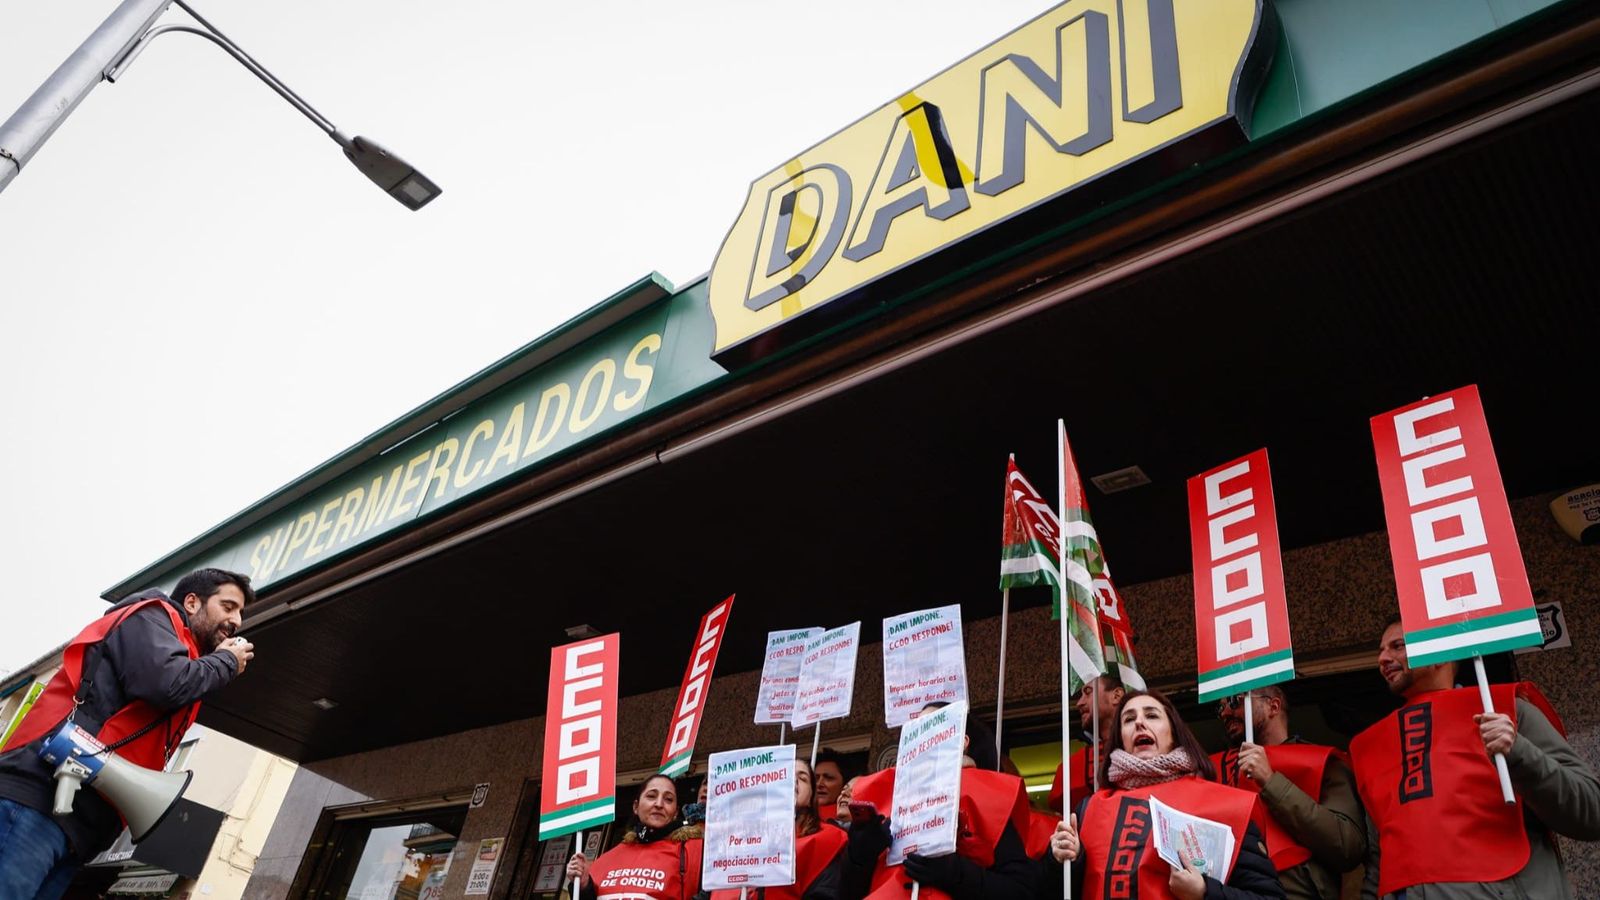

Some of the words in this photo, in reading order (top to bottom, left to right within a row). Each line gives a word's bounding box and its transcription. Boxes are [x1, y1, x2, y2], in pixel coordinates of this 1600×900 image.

[744, 0, 1183, 311] DANI
[249, 333, 662, 581] SUPERMERCADOS
[1393, 397, 1502, 620] CCOO
[1204, 460, 1270, 662] CCOO
[785, 644, 805, 656] RESPO
[889, 637, 909, 651] CCOO
[912, 621, 953, 643] RESPONDE!
[667, 603, 727, 758] CCOO
[889, 683, 916, 694] Imponer
[918, 676, 946, 687] horarios
[892, 697, 922, 708] vulnerar
[924, 689, 956, 701] derechos
[556, 640, 605, 805] CCOO
[918, 724, 956, 757] RESPONDE!
[740, 751, 777, 770] IMPONE.
[714, 780, 737, 797] CCOO
[739, 768, 787, 790] RESPONDE!
[729, 835, 743, 847] Por
[747, 836, 762, 845] una
[1110, 804, 1149, 898] CCOO
[607, 868, 666, 880] SERVICIO
[713, 855, 759, 871] negociación
[762, 852, 781, 865] real
[600, 878, 618, 887] DE
[620, 877, 665, 891] ORDEN
